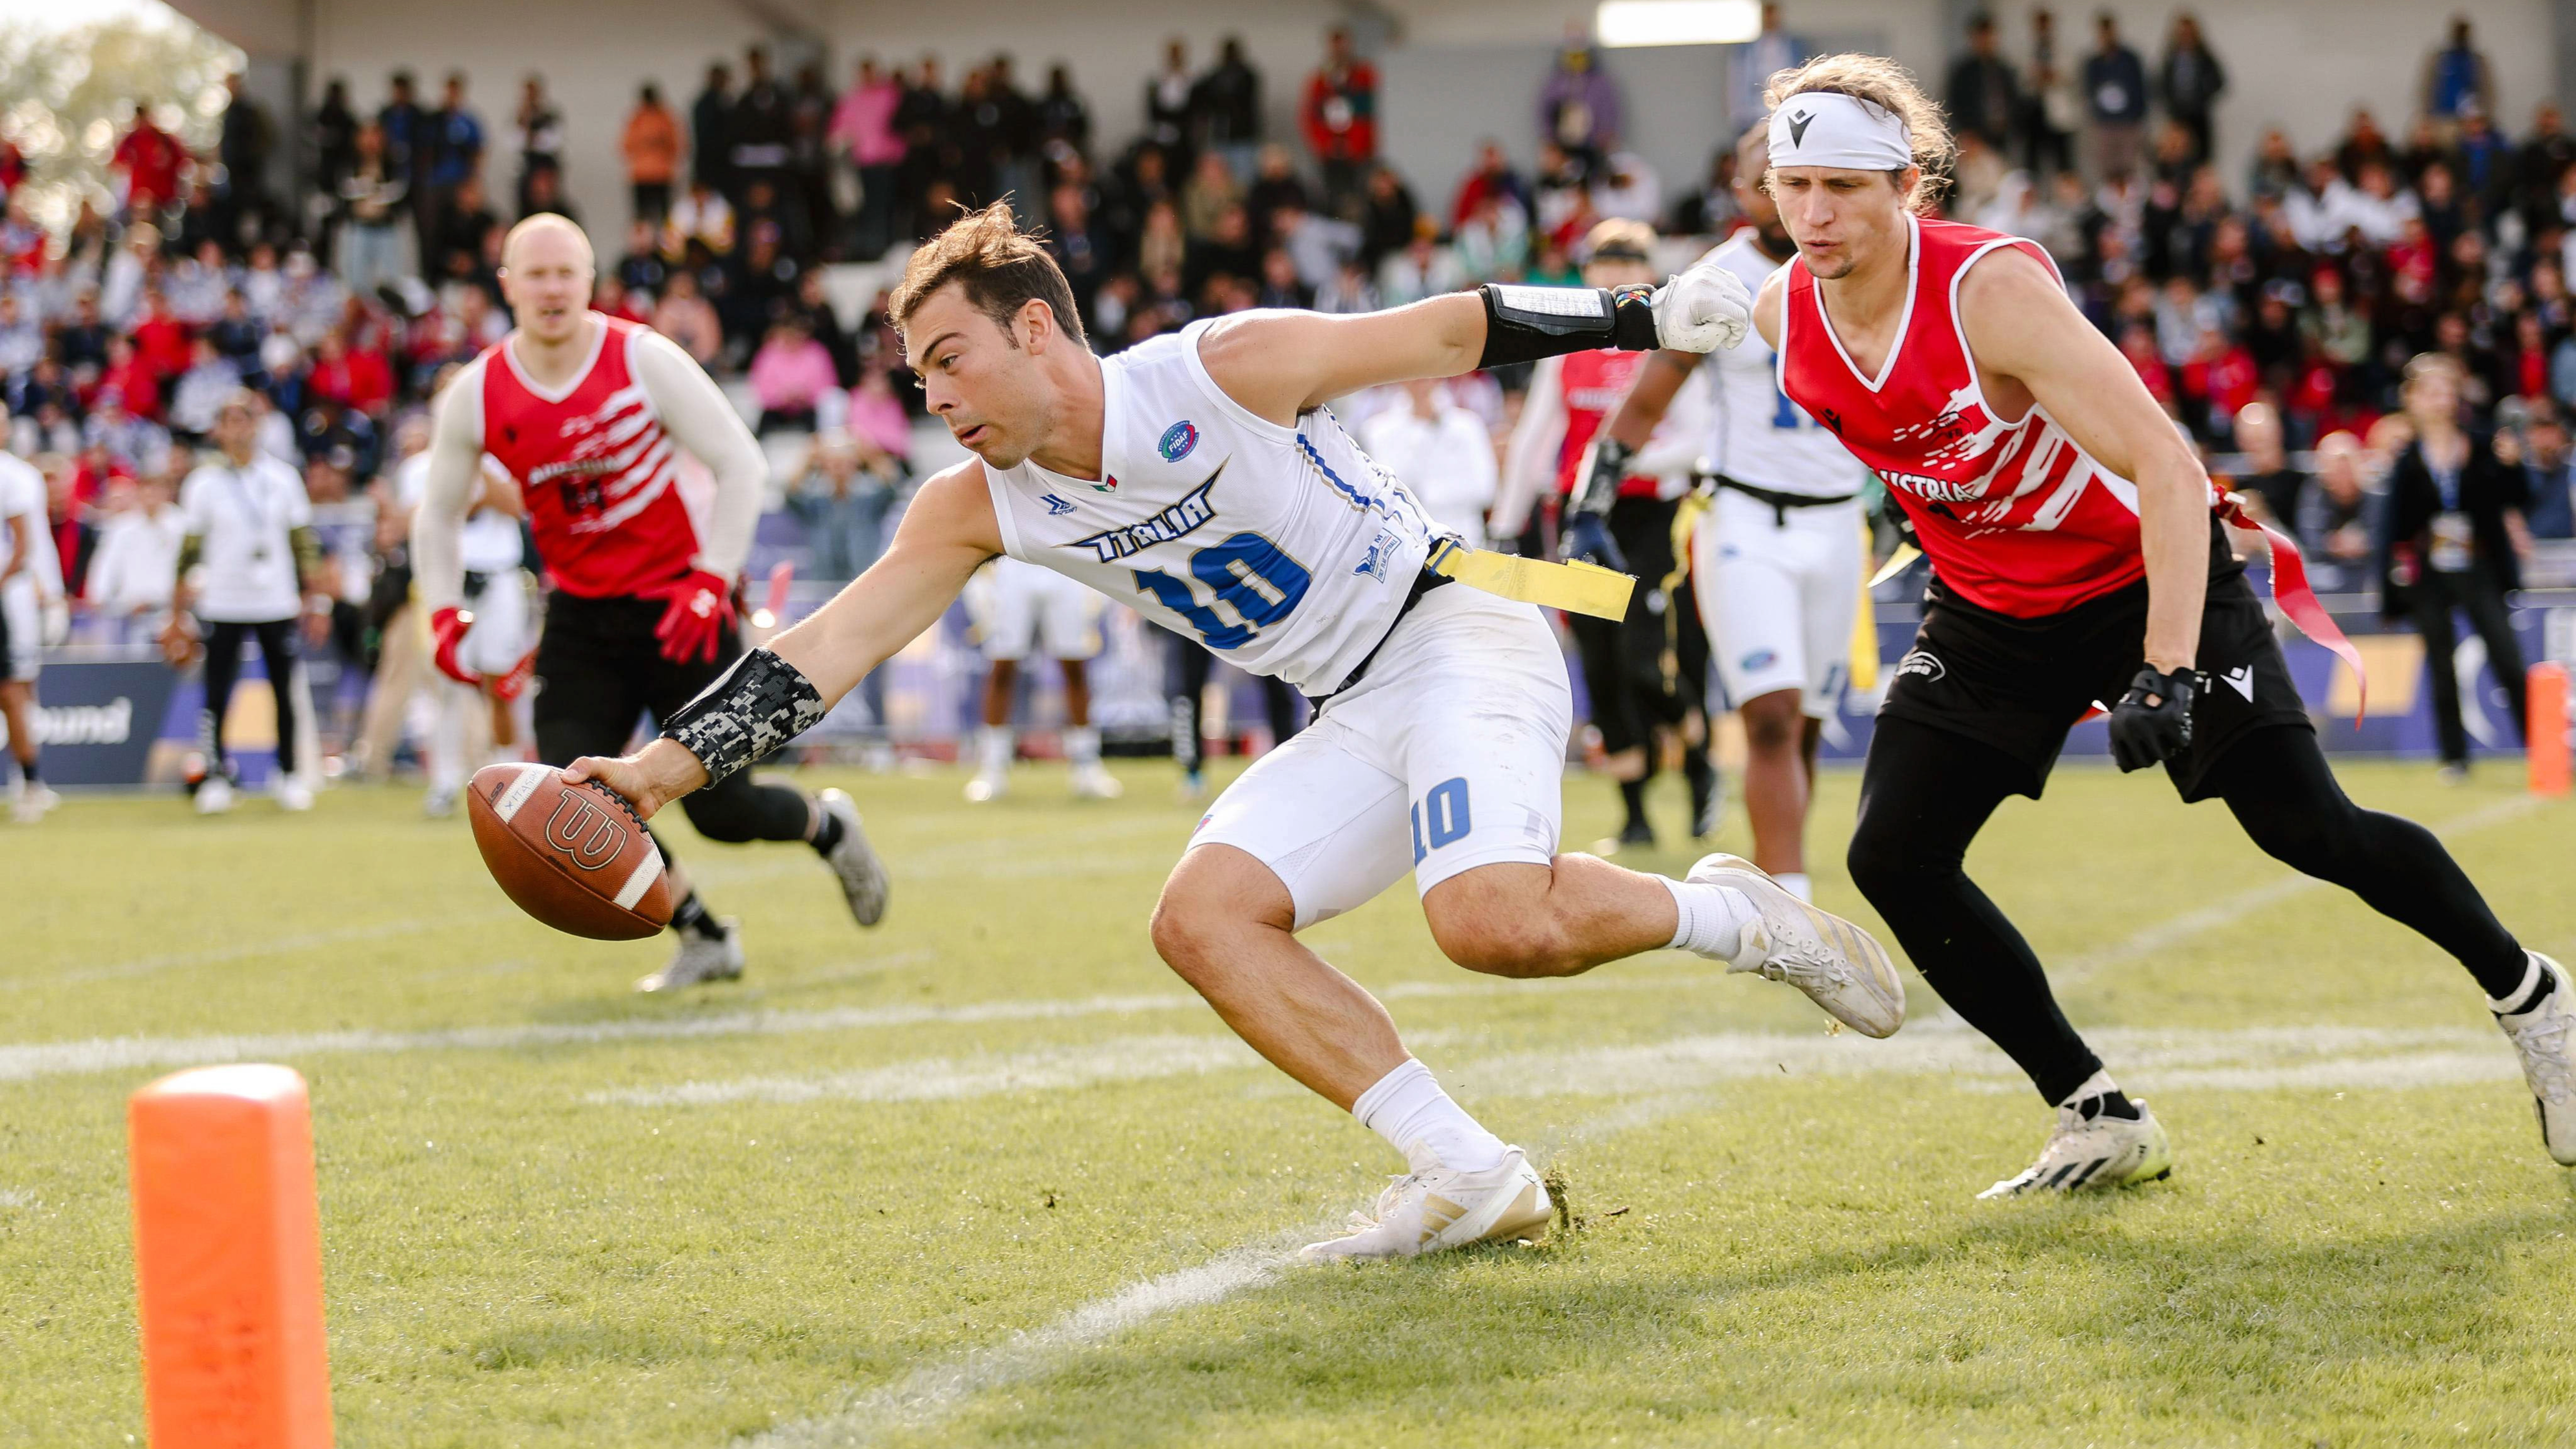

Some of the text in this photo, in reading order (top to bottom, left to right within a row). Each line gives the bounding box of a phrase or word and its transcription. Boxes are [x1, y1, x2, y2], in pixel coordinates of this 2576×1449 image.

[1168, 431, 1188, 453] FIDAF
[1068, 473, 1218, 564] ITALIA
[1878, 469, 1979, 502] USTRIA
[1130, 530, 1313, 650] 10
[545, 788, 628, 870] W
[1410, 776, 1472, 867] 10
